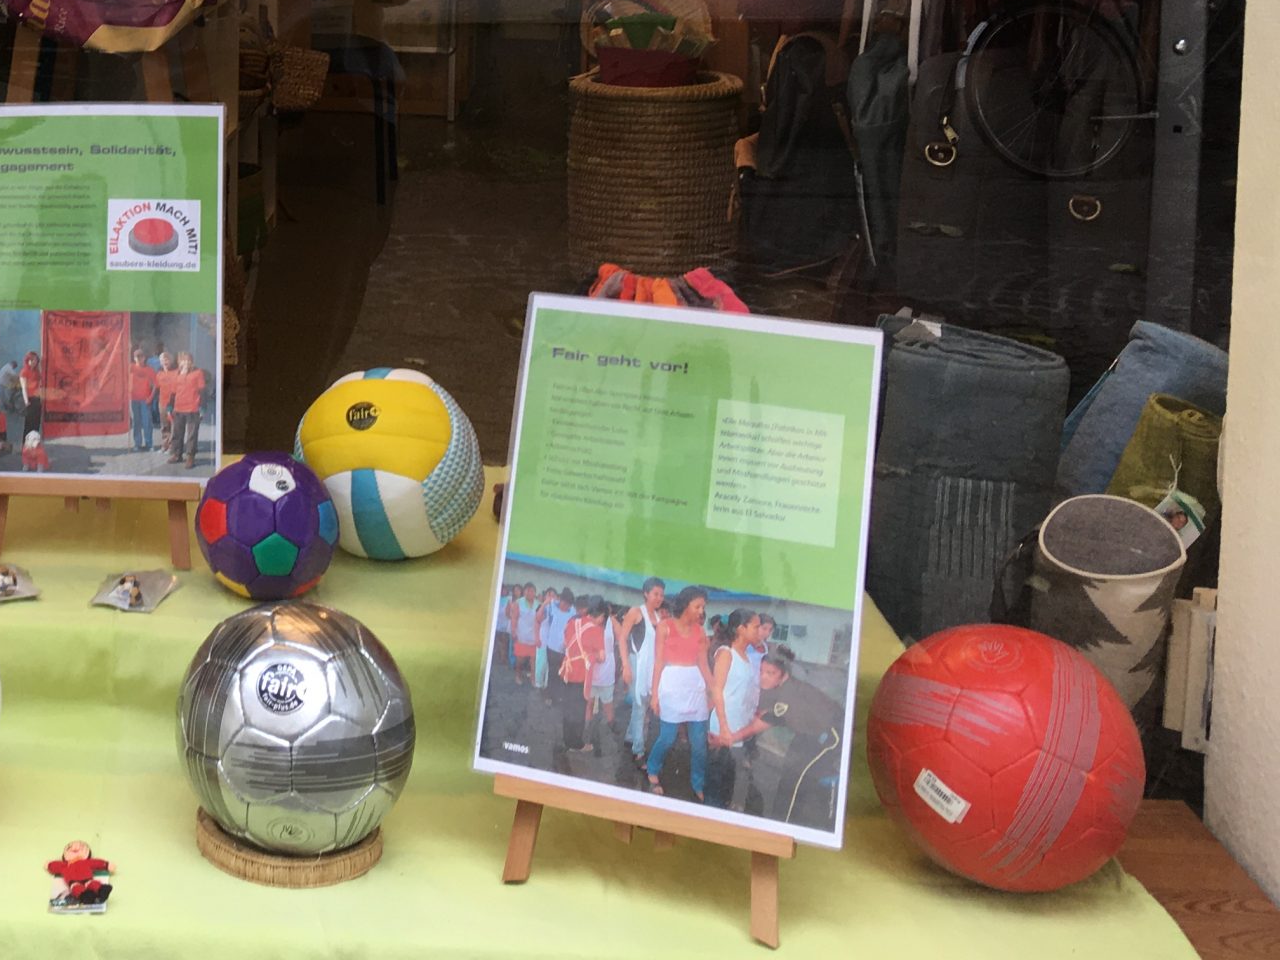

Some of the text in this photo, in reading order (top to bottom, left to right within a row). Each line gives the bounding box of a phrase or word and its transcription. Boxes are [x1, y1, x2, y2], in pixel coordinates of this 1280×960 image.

[90, 144, 176, 157] Solidarität,
[110, 202, 150, 254] EILAKTION
[156, 202, 190, 226] MACH
[552, 347, 689, 374] Fair geht vor!
[261, 671, 300, 698] fair
